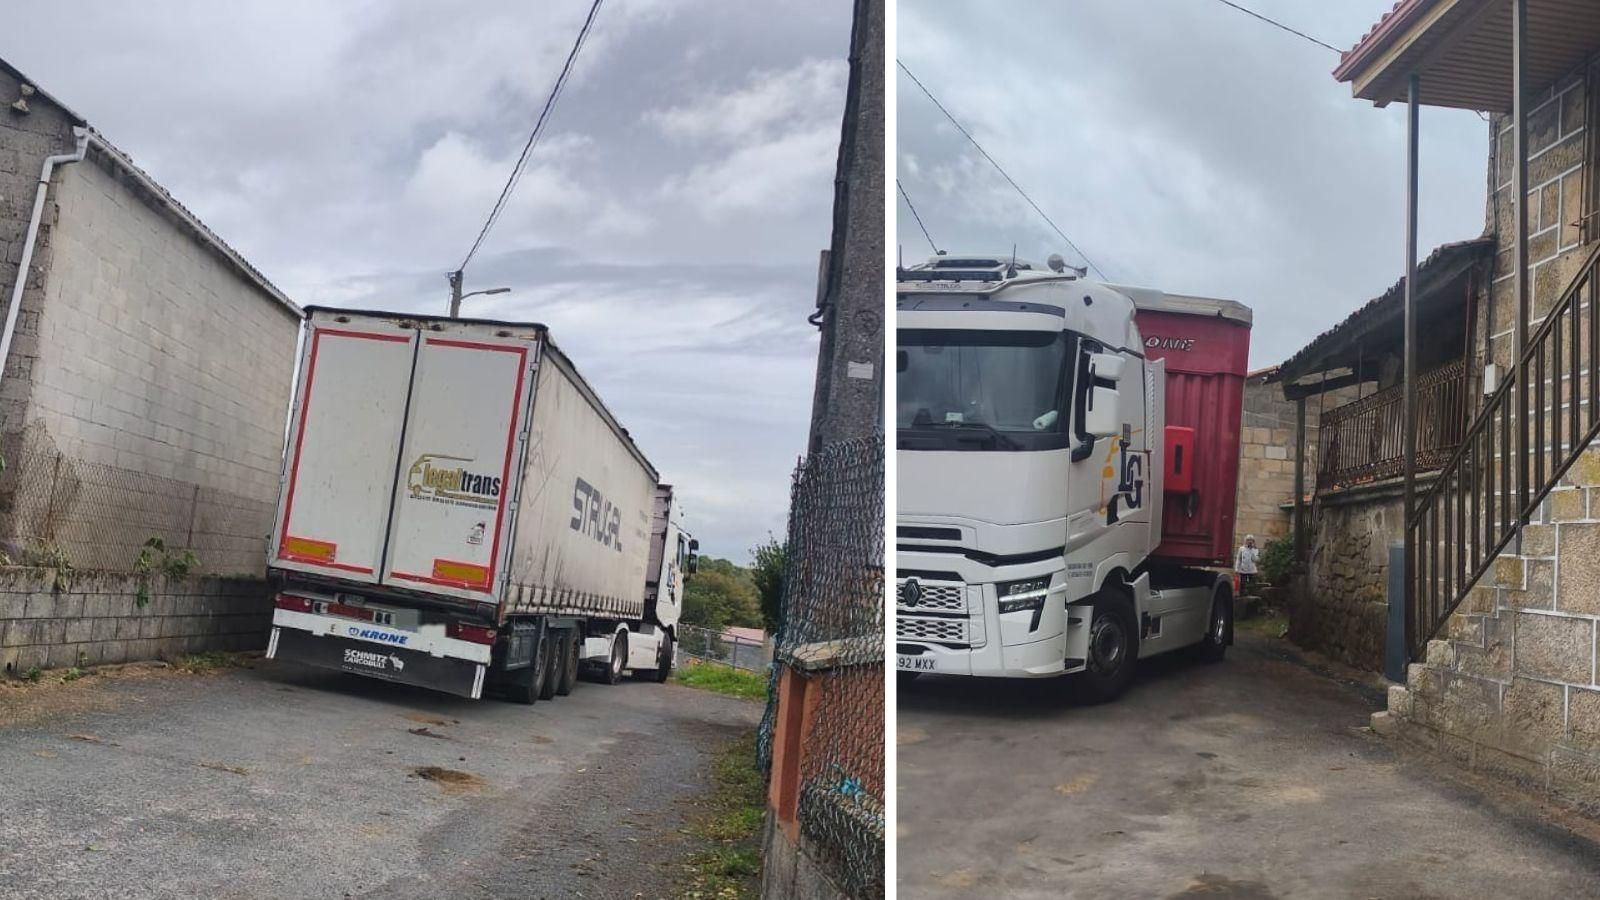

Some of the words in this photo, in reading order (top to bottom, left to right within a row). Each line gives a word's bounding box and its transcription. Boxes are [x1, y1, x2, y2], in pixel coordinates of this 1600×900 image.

[1145, 336, 1195, 351] ONE
[569, 476, 622, 553] STRUGAL
[359, 628, 409, 645] KRONE
[343, 648, 389, 664] SCHMITZ
[896, 656, 912, 669] 92
[914, 657, 937, 670] MXX
